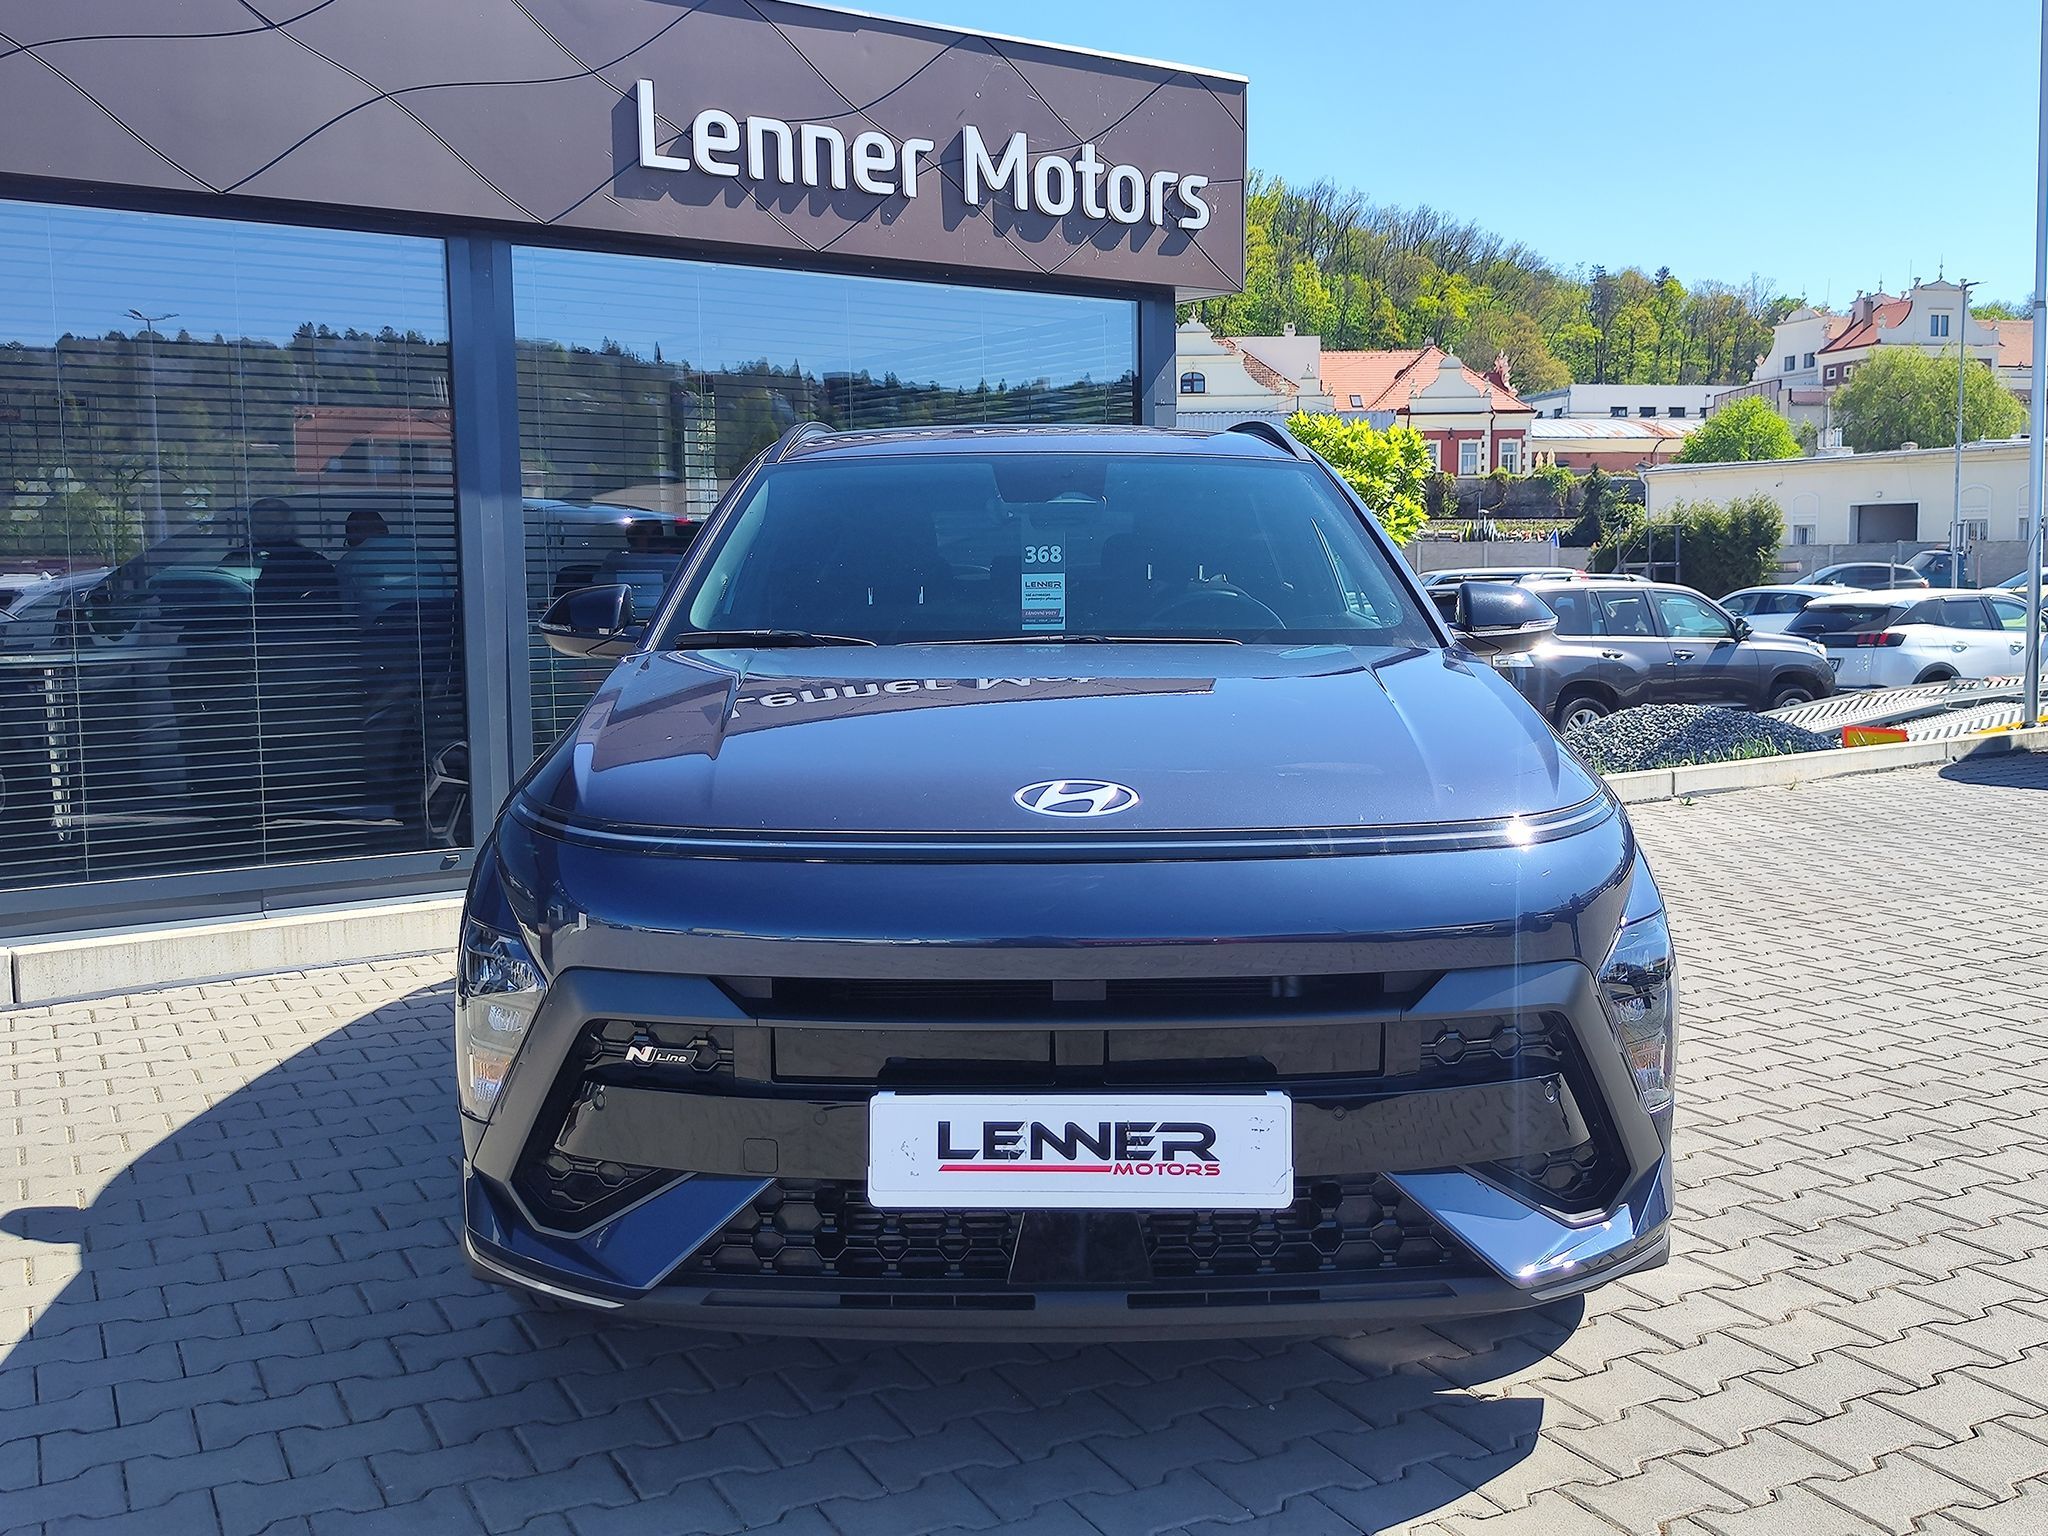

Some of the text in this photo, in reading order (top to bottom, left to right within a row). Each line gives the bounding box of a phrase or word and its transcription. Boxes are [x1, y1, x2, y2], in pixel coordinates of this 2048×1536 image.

[636, 78, 1211, 230] Lenner Motors
[1024, 545, 1063, 564] 368
[1024, 581, 1062, 589] LENNER
[625, 1046, 687, 1062] N Line
[937, 1120, 1220, 1162] LENNER
[1113, 1162, 1221, 1176] MOTORS
